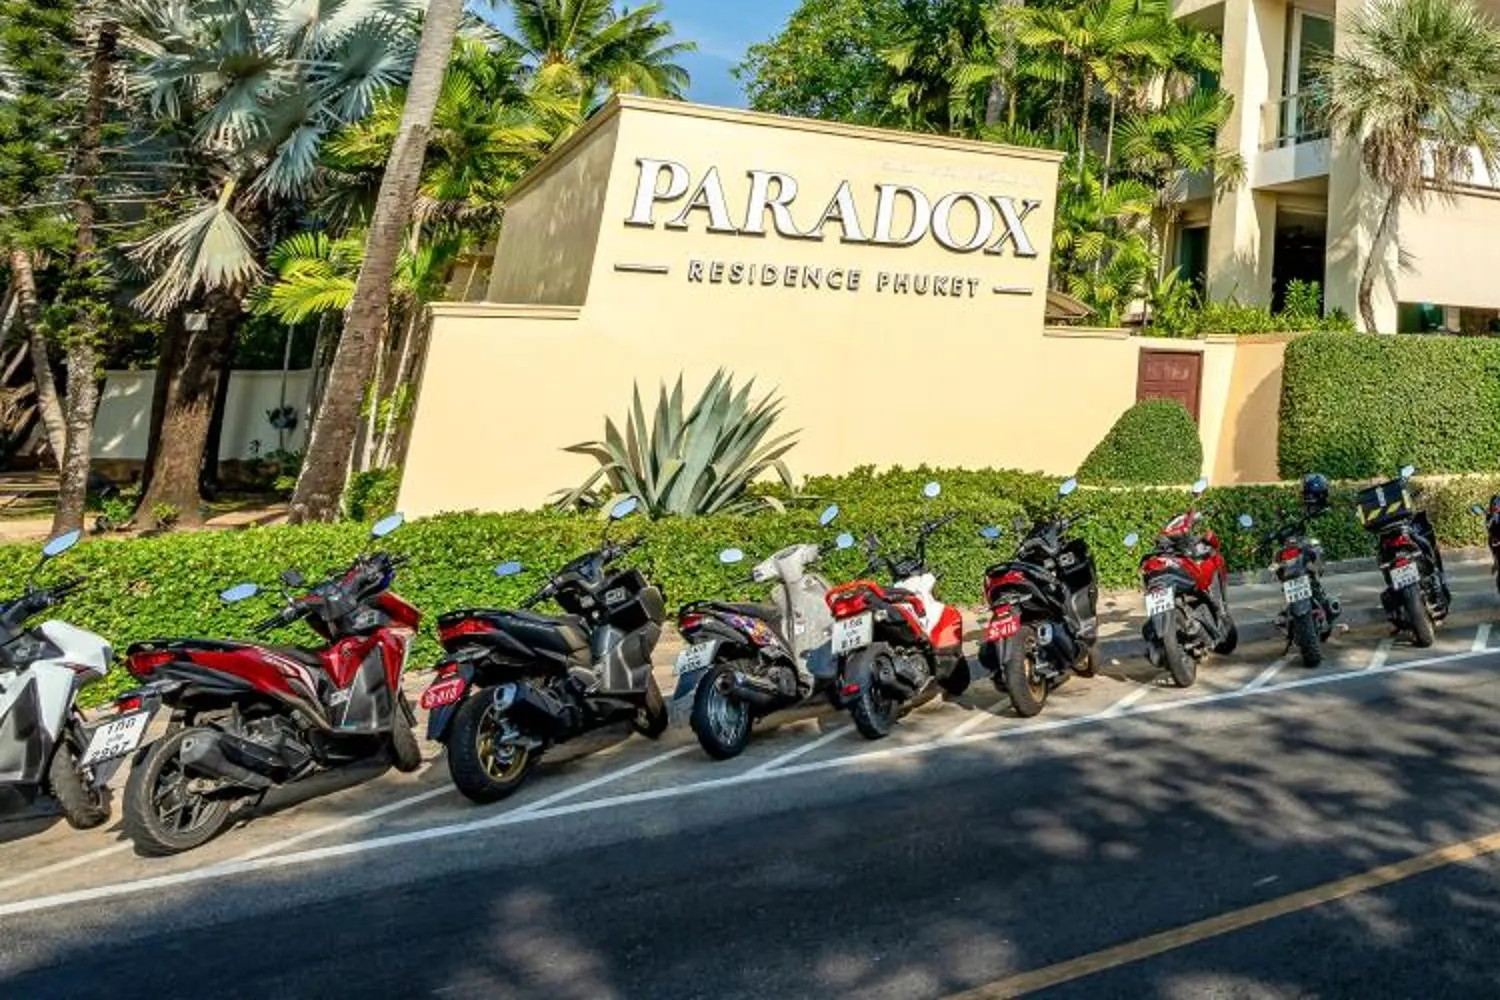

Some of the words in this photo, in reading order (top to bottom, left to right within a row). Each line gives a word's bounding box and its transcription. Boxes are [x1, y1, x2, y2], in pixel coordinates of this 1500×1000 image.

[624, 157, 1042, 259] PARADOX
[687, 258, 861, 292] RESIDENCE
[876, 270, 980, 299] PHUKET
